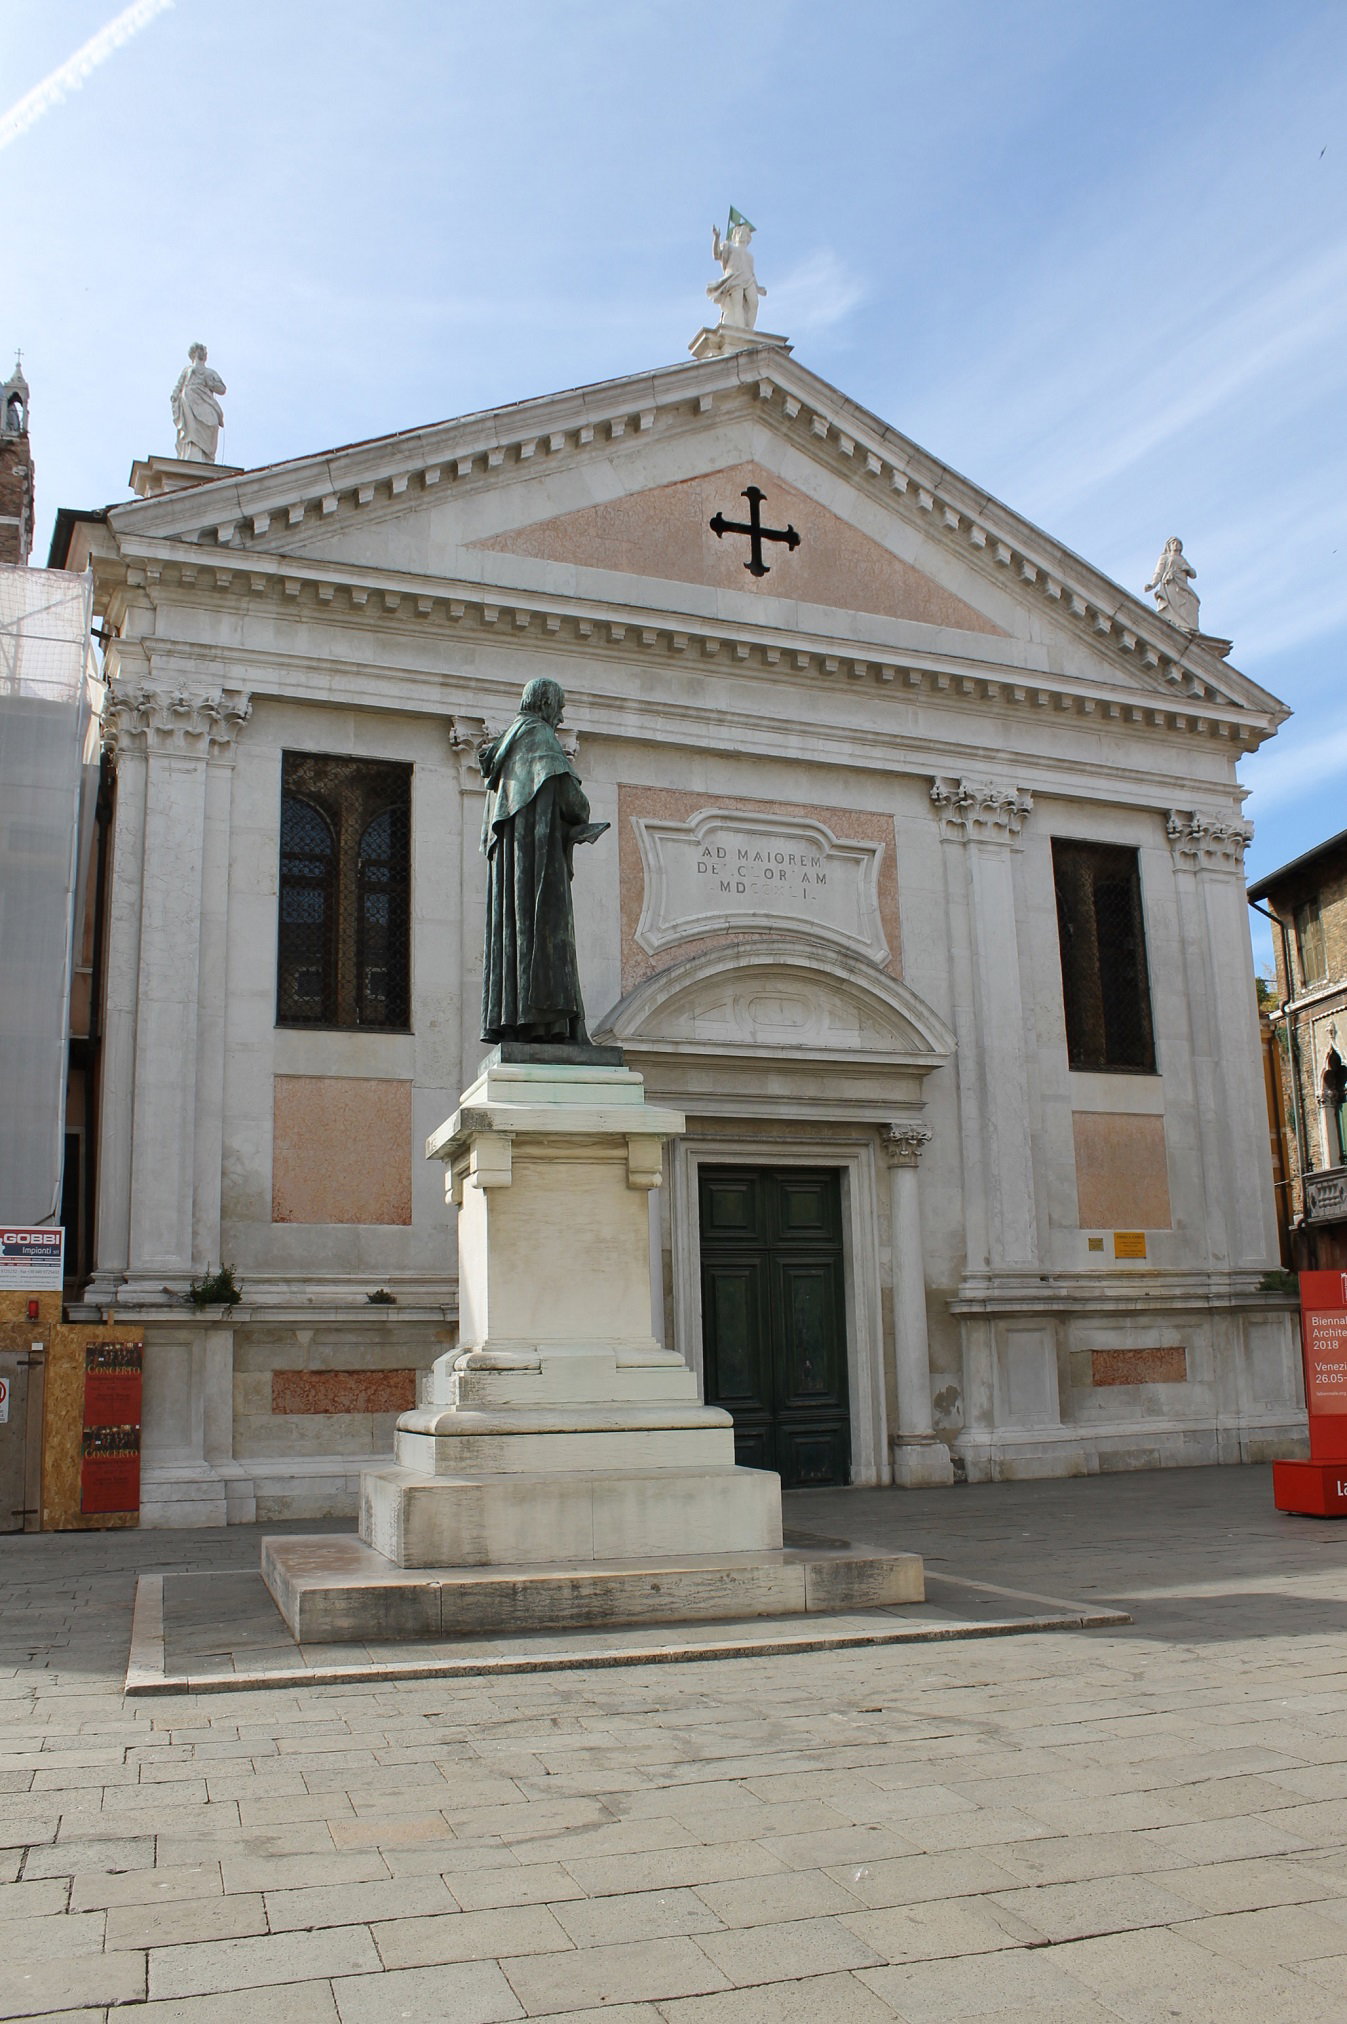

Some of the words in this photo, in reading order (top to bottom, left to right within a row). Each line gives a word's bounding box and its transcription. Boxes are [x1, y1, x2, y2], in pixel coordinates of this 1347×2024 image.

[702, 846, 727, 859] AD
[737, 848, 821, 868] MAIOREM
[697, 861, 727, 875] DE
[3, 1233, 60, 1245] GOBBI
[22, 1246, 52, 1255] Impianti
[1313, 1340, 1339, 1350] 2018
